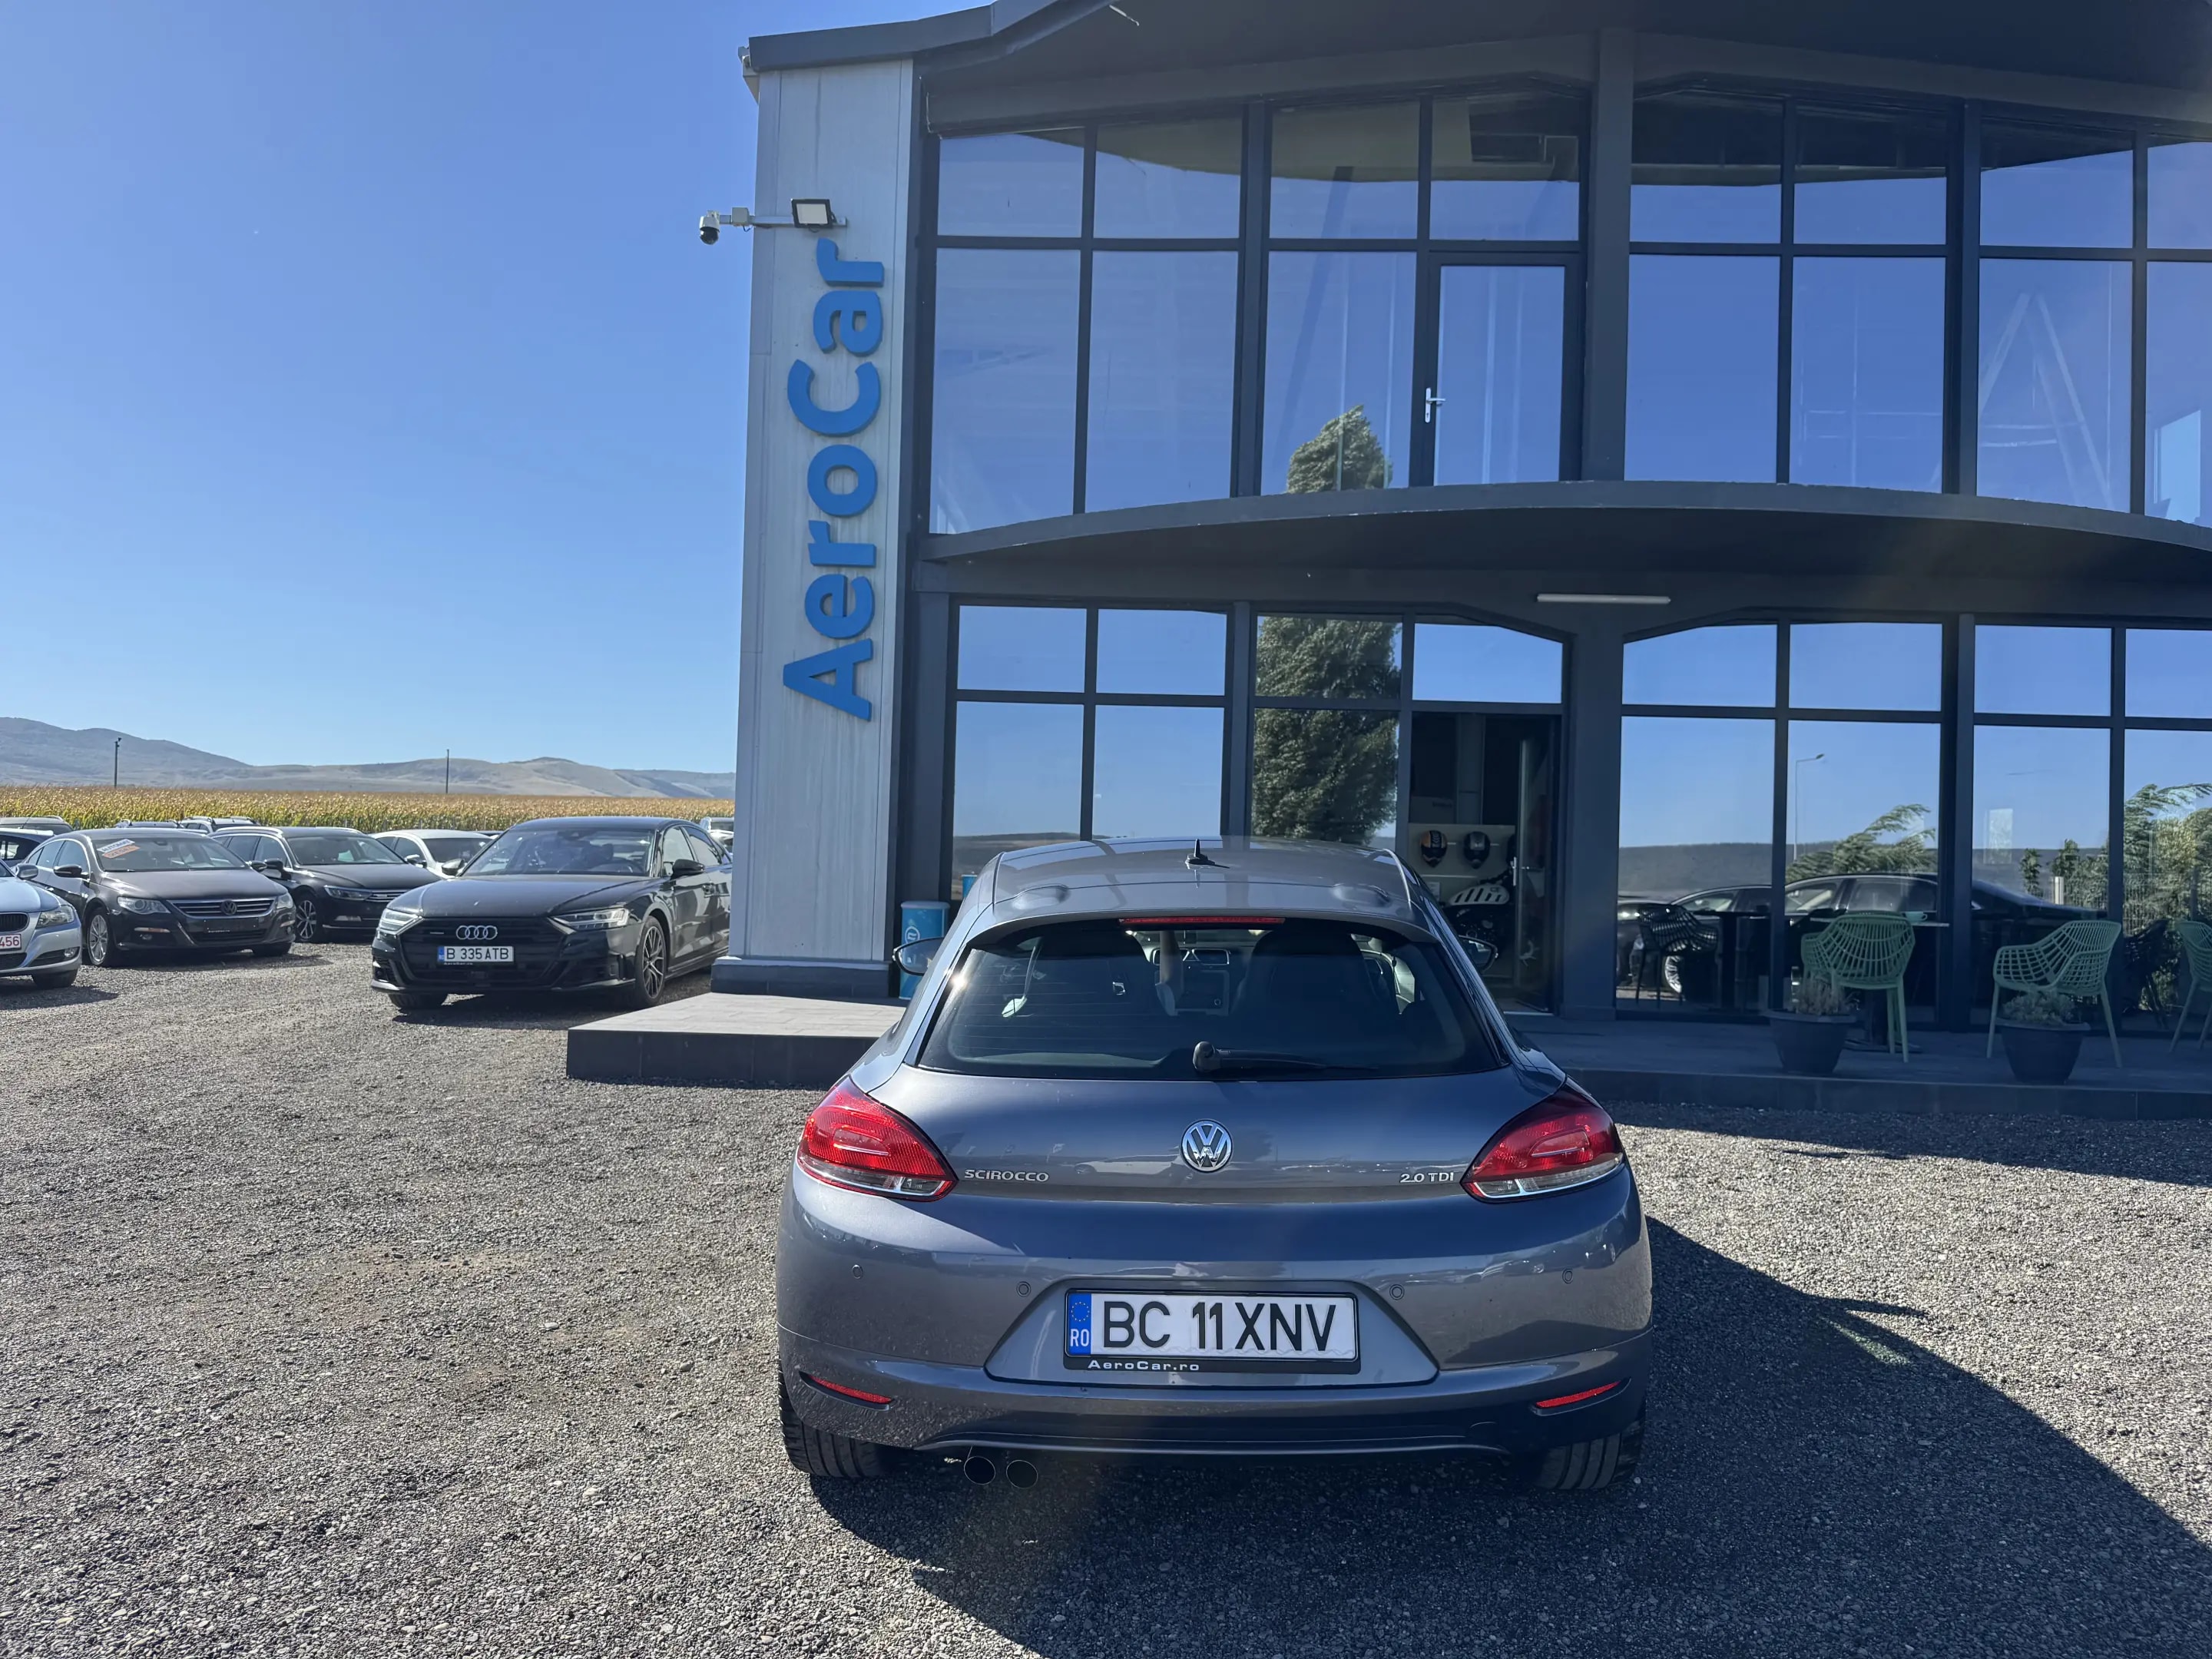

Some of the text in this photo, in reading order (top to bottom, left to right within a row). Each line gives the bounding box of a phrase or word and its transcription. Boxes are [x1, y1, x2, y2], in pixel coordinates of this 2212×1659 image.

[783, 237, 885, 720] AeroCar
[0, 936, 19, 946] 456
[446, 948, 455, 960] B
[461, 948, 482, 960] 335
[485, 948, 509, 960] ATB
[964, 1169, 1049, 1183] SCIROCCO
[1400, 1172, 1454, 1183] 2.0 TDI
[1104, 1301, 1336, 1352] BC 11 XNV
[1070, 1328, 1090, 1347] RO
[1088, 1359, 1200, 1371] AeroCar.ro
